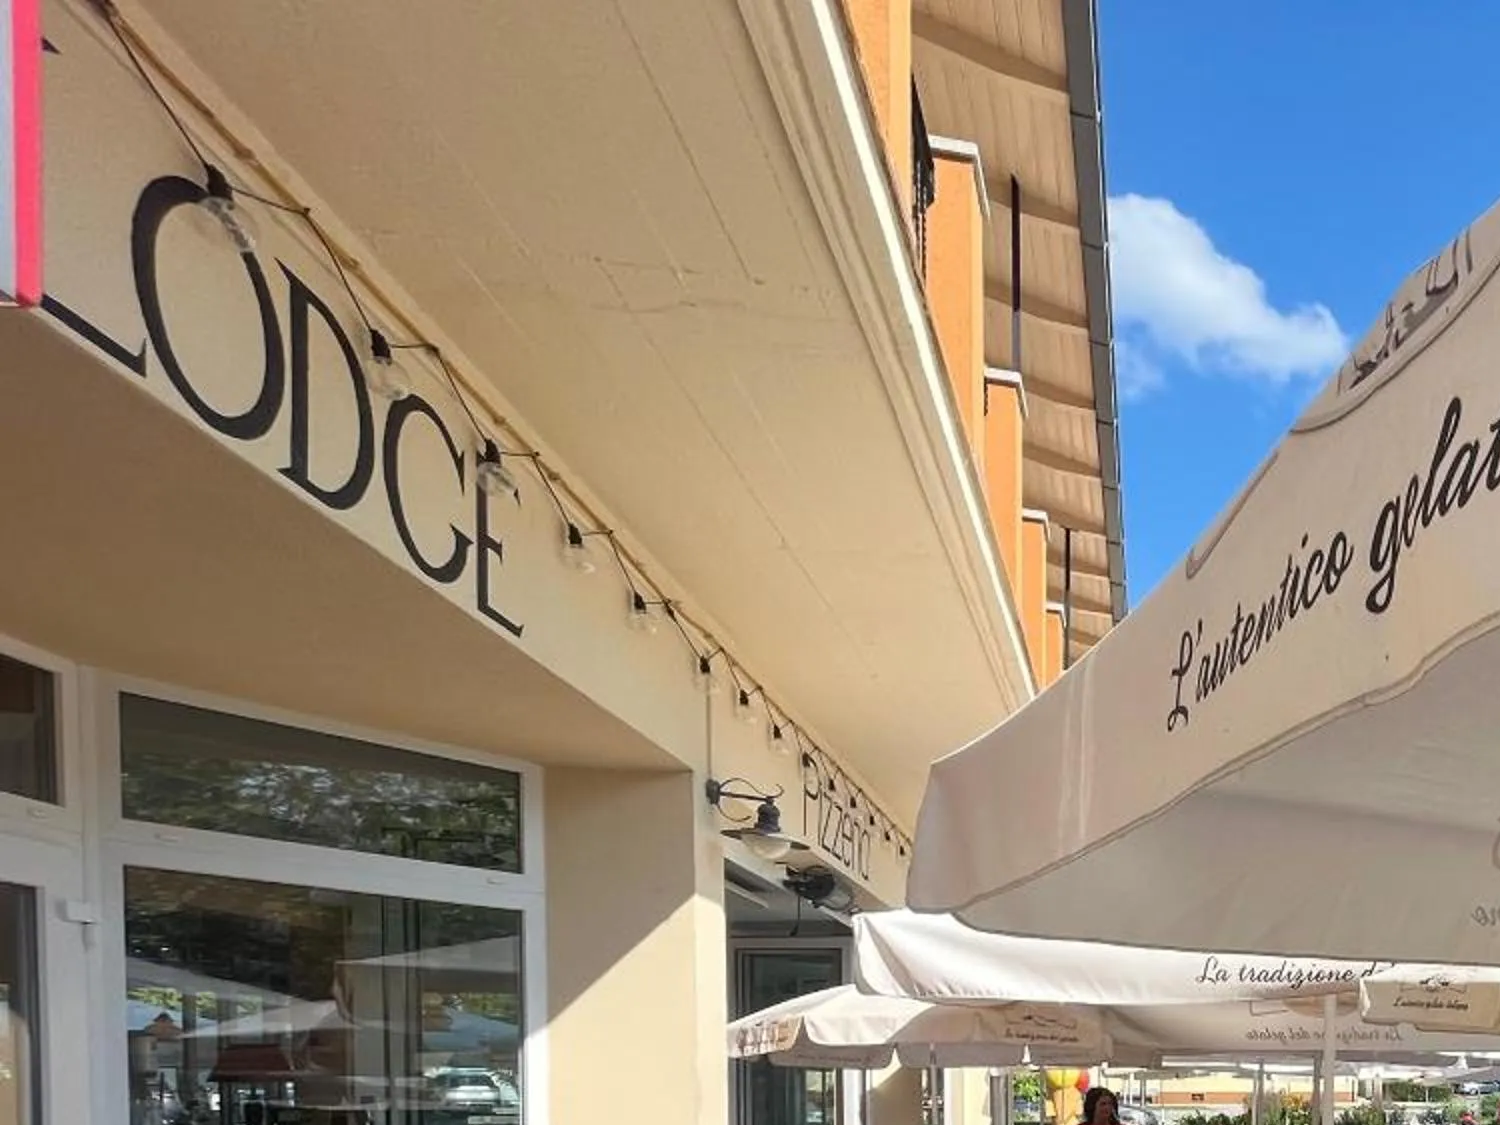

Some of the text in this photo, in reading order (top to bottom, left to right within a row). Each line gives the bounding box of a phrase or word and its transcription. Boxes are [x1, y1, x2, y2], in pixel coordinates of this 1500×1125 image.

[42, 36, 525, 638] ODGE
[1168, 531, 1352, 731] L'autentico
[1196, 956, 1230, 985] La
[1239, 960, 1355, 990] tradizione
